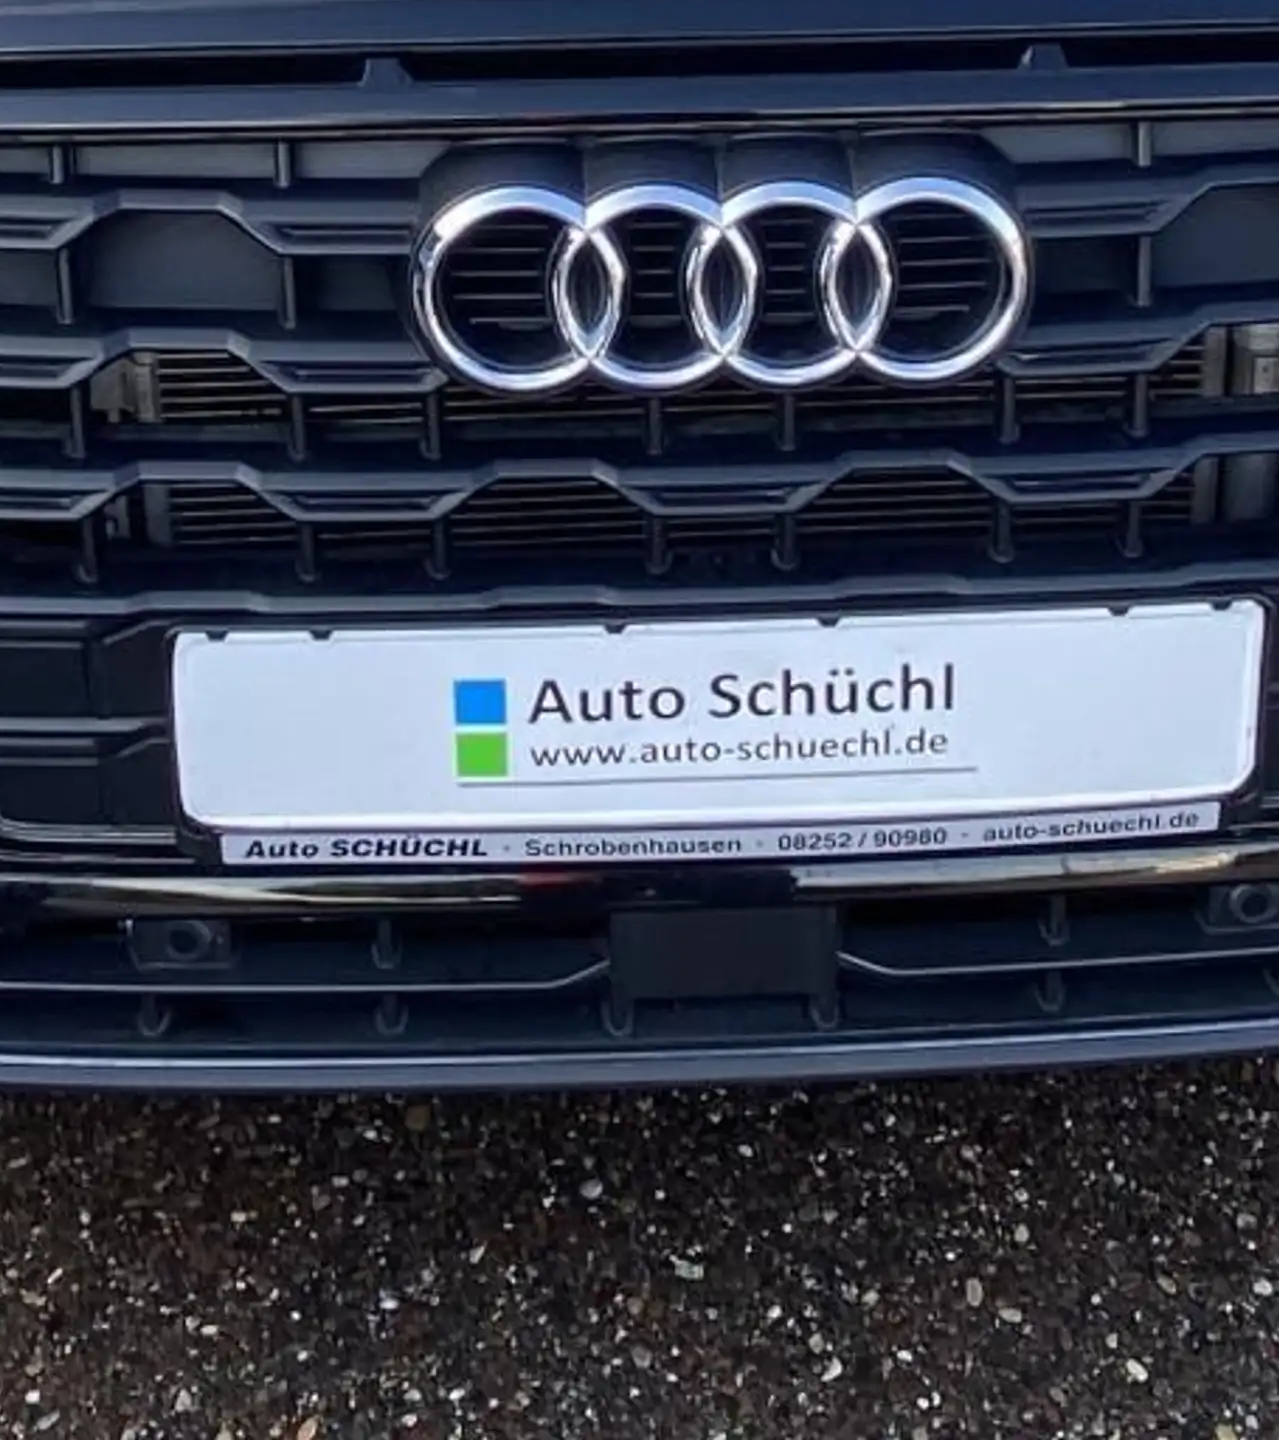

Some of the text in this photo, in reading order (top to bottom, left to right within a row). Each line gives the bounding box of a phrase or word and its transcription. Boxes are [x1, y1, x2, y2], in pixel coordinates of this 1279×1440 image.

[528, 662, 955, 724] Auto Schüchl
[529, 727, 949, 767] www.auto-schuechl.de
[244, 839, 320, 859] Auto
[329, 833, 489, 858] SCHÜCHL
[524, 836, 742, 857] Schrobenhausen
